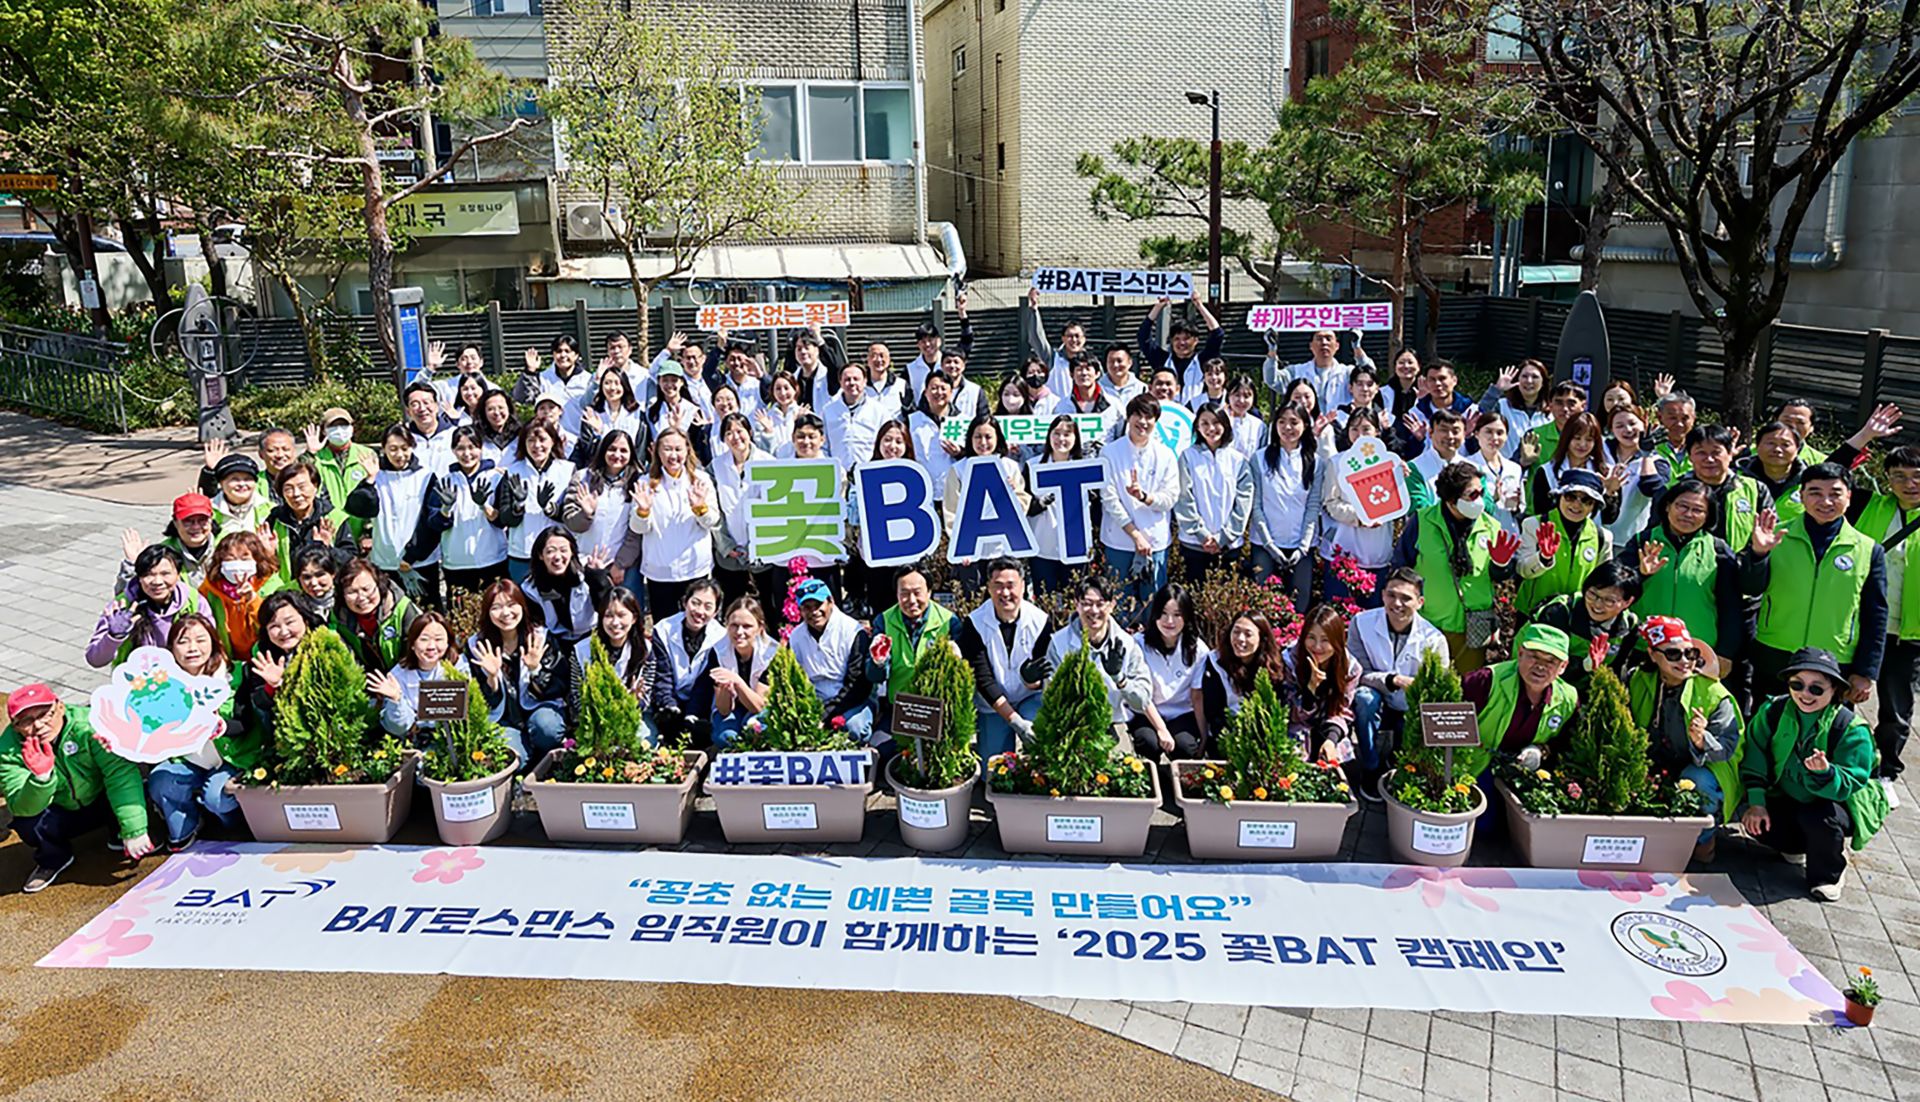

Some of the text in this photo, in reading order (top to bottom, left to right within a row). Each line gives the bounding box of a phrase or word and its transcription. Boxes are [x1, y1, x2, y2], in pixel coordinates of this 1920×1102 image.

[1037, 269, 1190, 296] #BAT로스만스
[700, 303, 847, 328] #꽁초없는꽃길
[1252, 305, 1390, 328] #깨끗한골목
[714, 754, 867, 785] #꽃BAT
[174, 889, 297, 908] BAT
[746, 882, 833, 909] 없는
[847, 886, 933, 912] 예쁜
[949, 888, 1034, 917] 골목
[321, 905, 615, 940] BAT로스만스
[629, 914, 828, 948] 임직원이
[842, 921, 1039, 956] 함께하는
[1221, 933, 1378, 967] 꽃BAT
